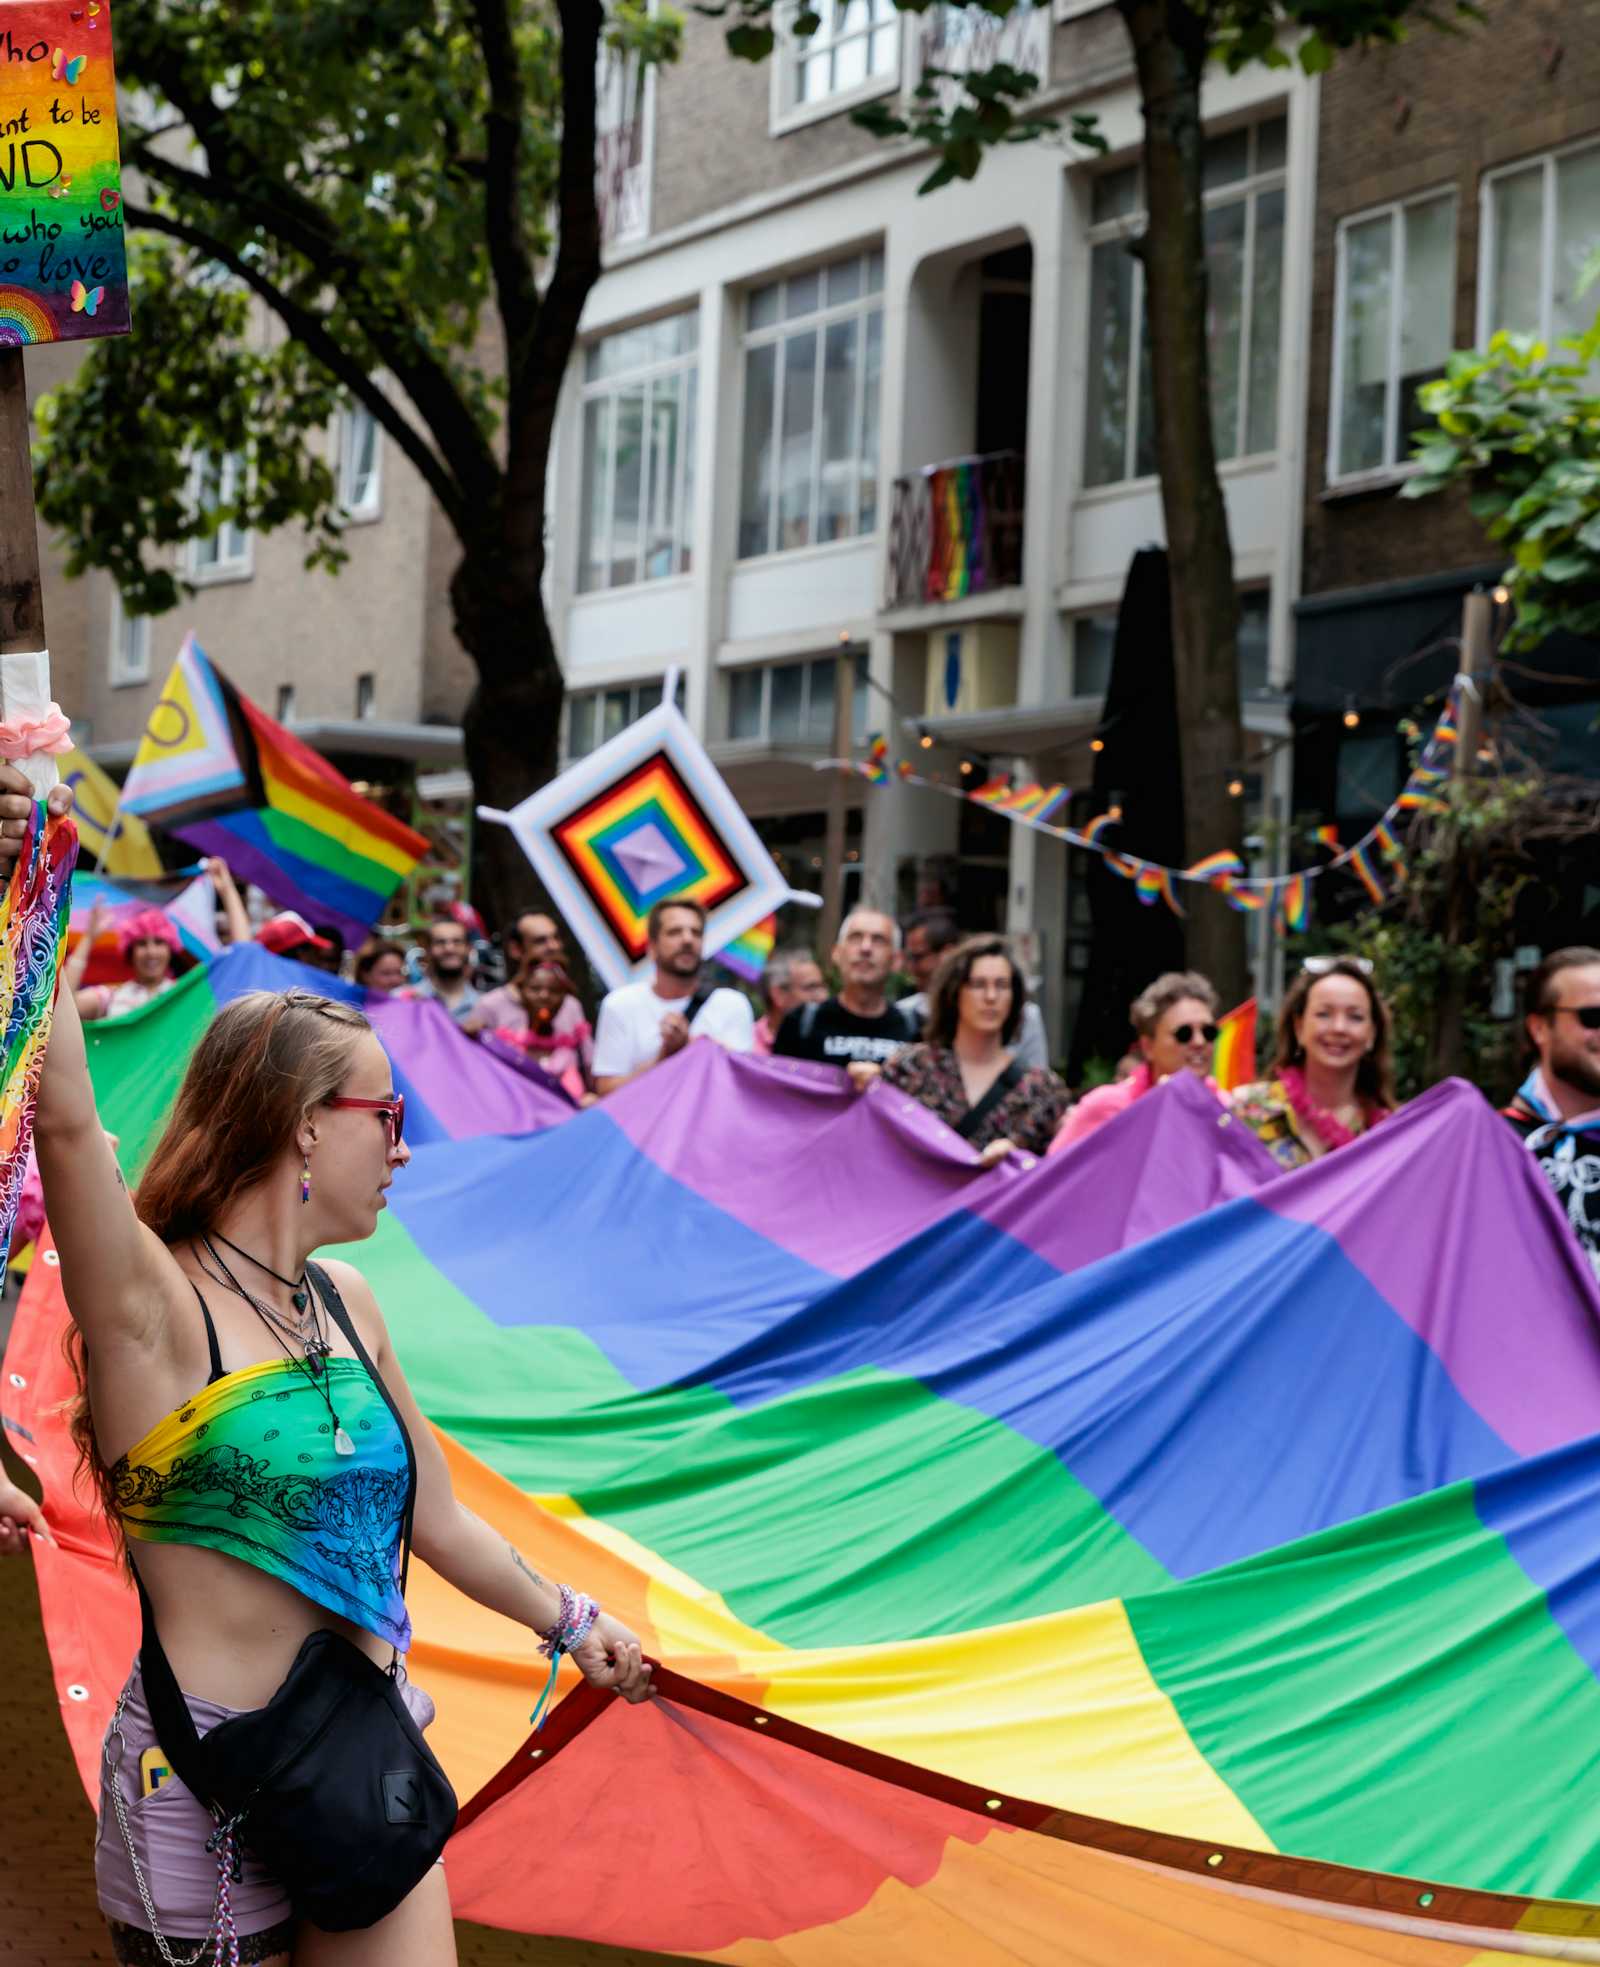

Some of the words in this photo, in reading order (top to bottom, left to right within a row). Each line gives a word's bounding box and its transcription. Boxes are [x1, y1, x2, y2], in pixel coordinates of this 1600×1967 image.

[0, 30, 49, 62] ho
[0, 107, 31, 138] nt
[49, 98, 74, 125] to
[82, 96, 101, 125] be
[3, 207, 62, 244] who
[80, 211, 123, 239] you
[38, 243, 110, 283] love
